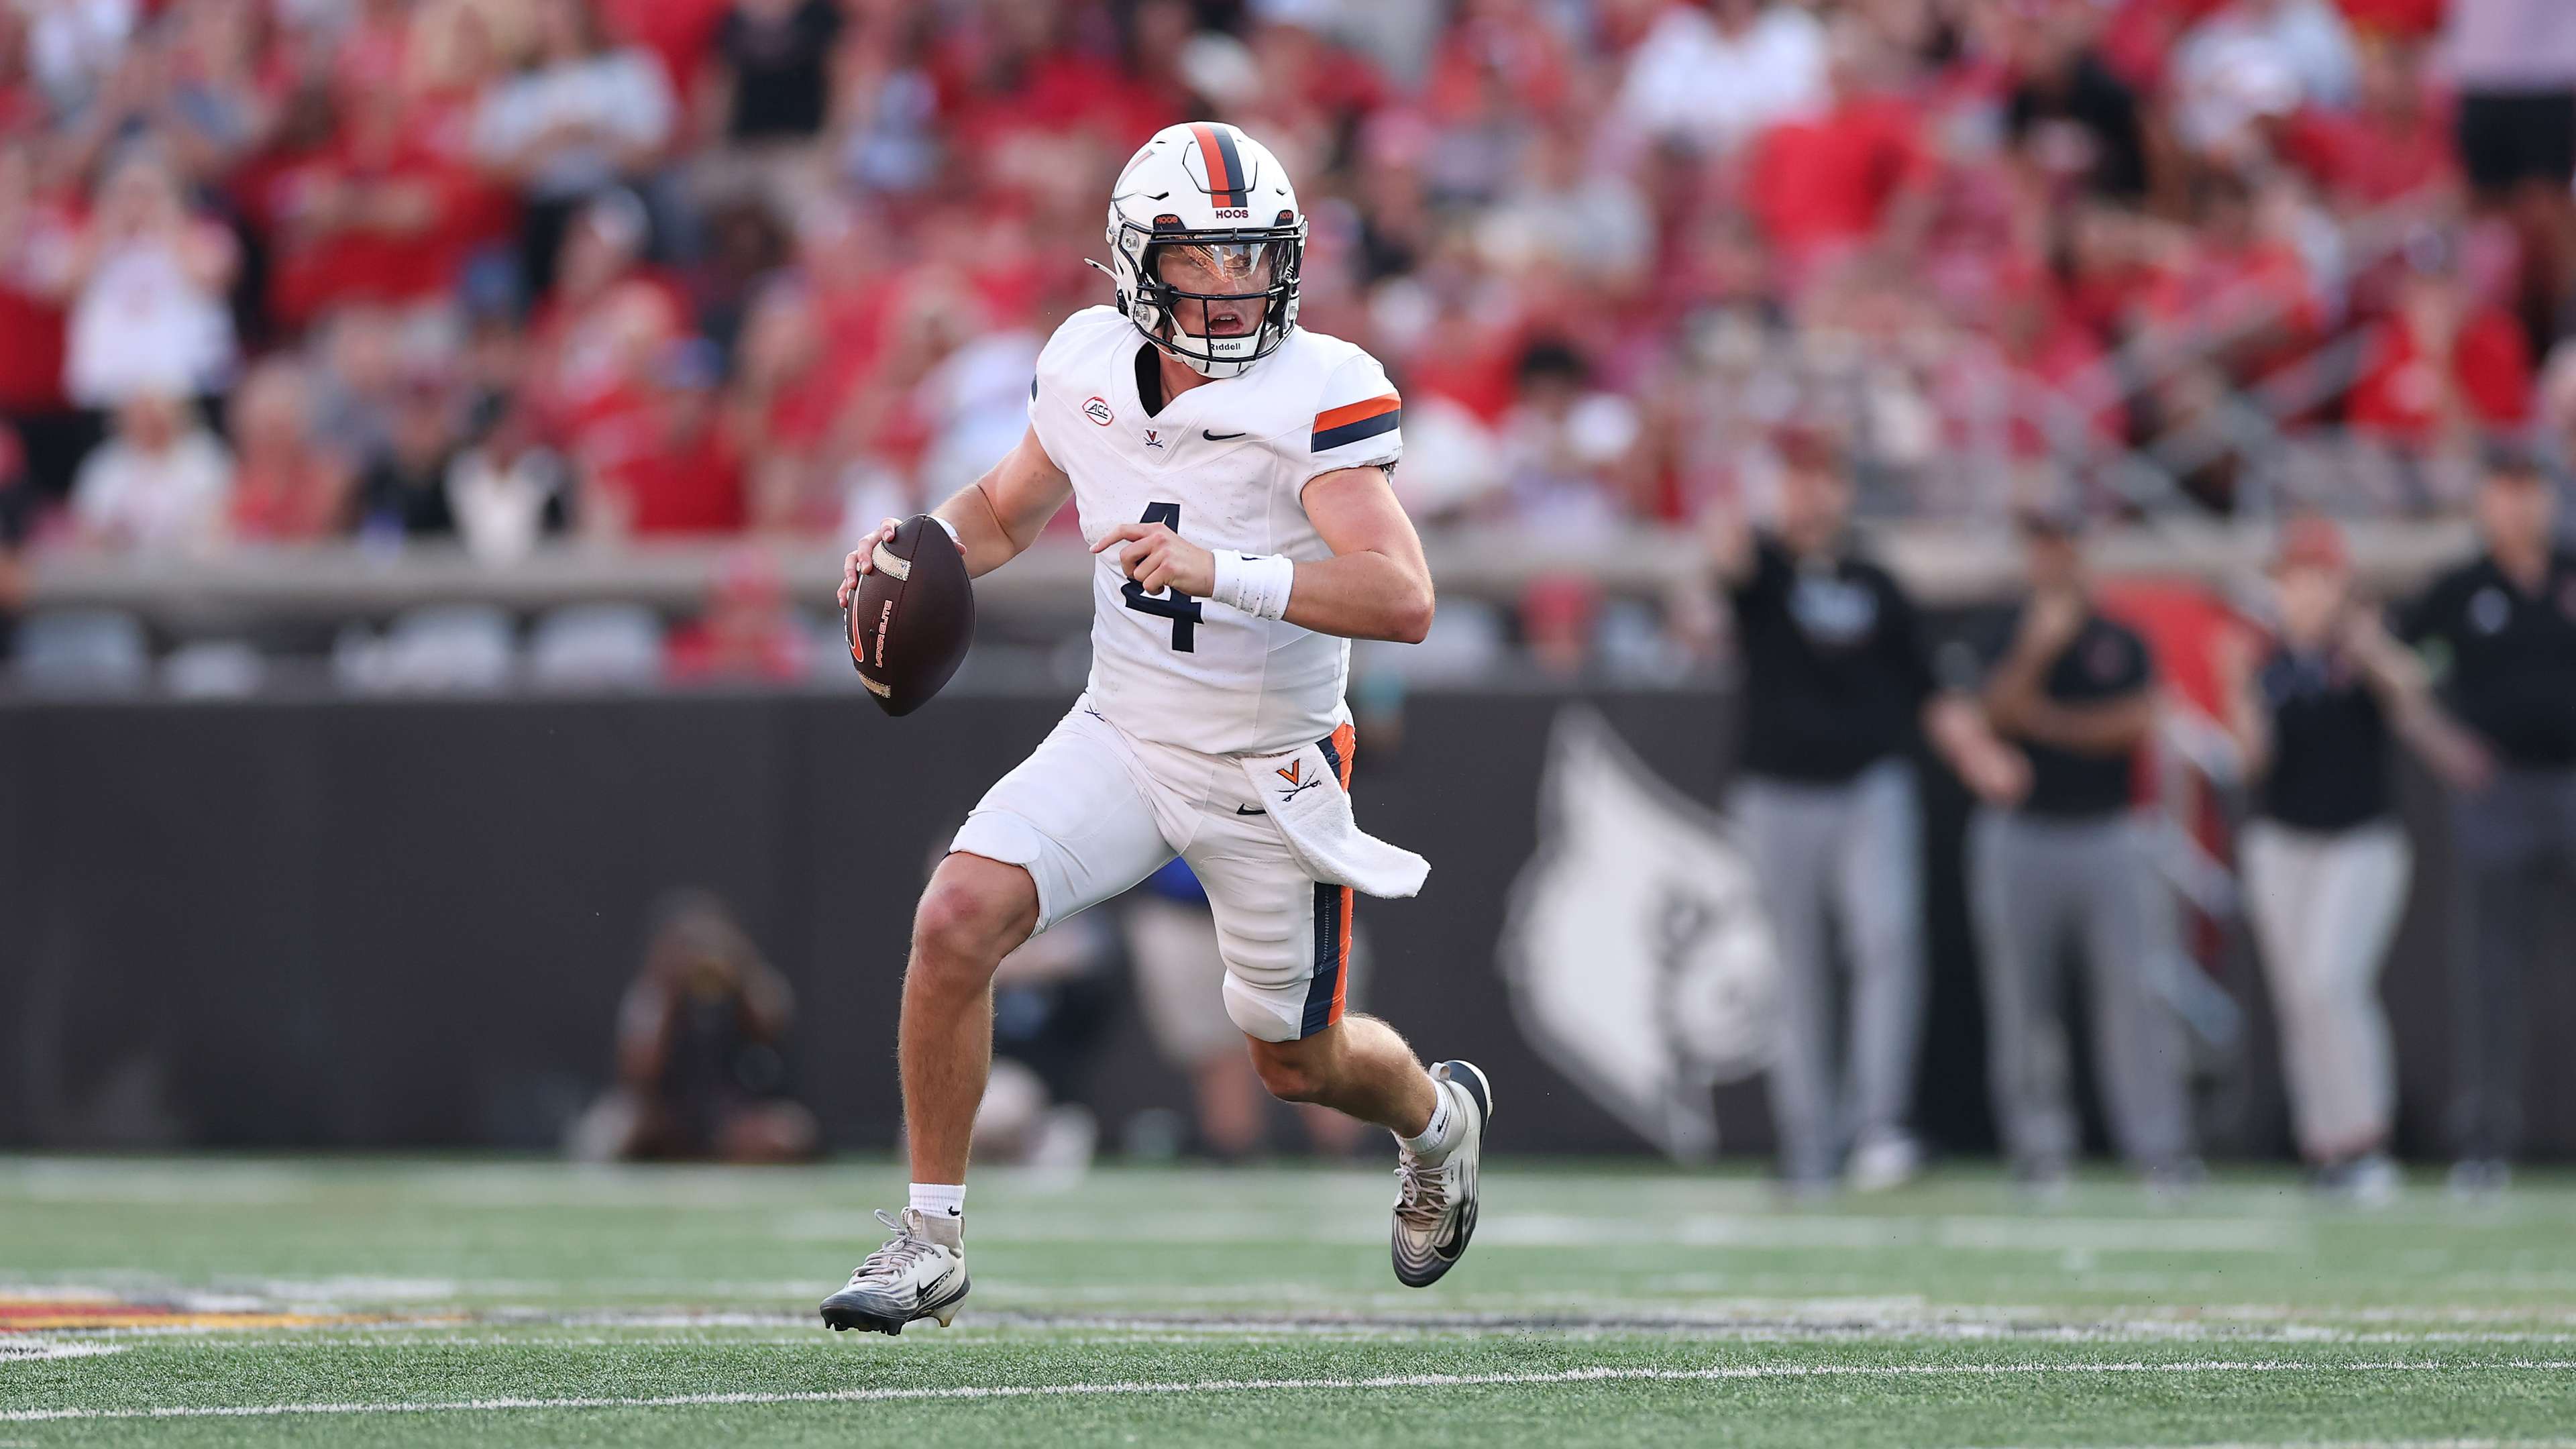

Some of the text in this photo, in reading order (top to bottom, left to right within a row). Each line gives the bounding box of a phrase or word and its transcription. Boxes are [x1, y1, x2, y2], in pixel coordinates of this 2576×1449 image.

[1216, 209, 1249, 219] HOOS
[1210, 343, 1241, 351] Riddell
[1088, 403, 1108, 417] ACC
[1121, 501, 1205, 653] 4
[875, 600, 893, 668] VAPOR ELITE
